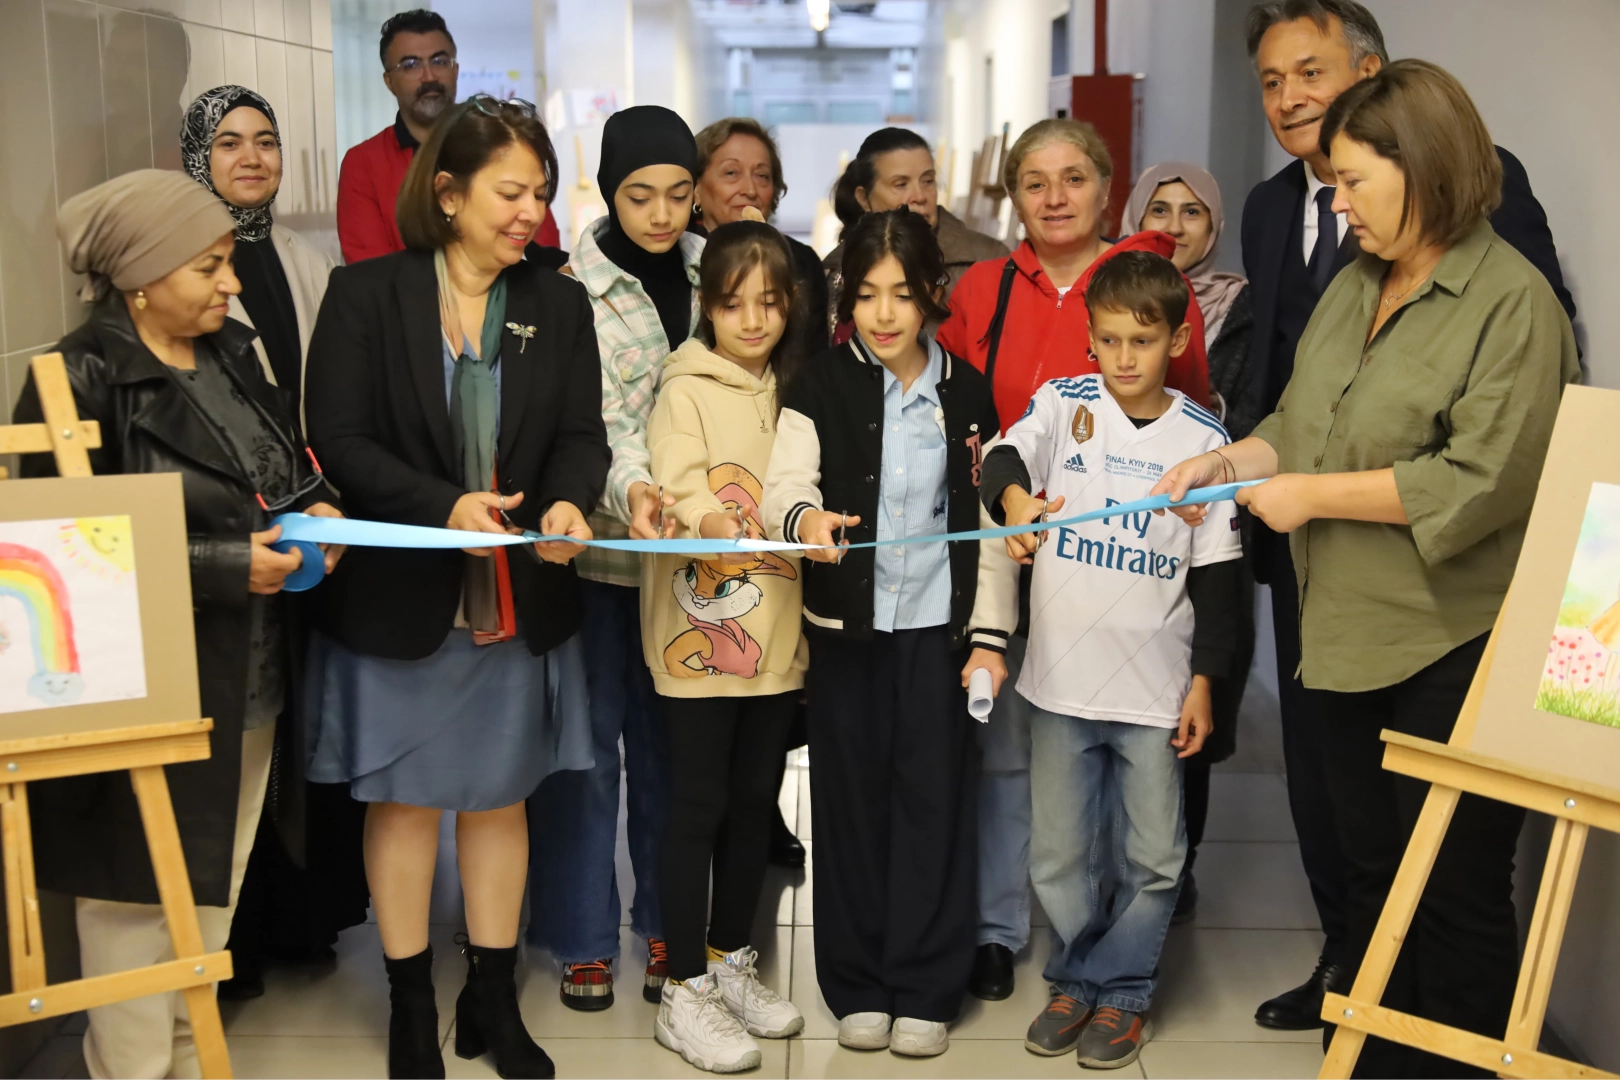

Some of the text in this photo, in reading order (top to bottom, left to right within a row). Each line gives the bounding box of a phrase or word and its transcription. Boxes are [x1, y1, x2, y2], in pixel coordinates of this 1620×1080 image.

[1063, 463, 1088, 474] adidas
[1105, 454, 1164, 473] FINAL KYIV 2018
[1135, 474, 1156, 482] LIVERPOOL
[1056, 526, 1181, 580] Emirates
